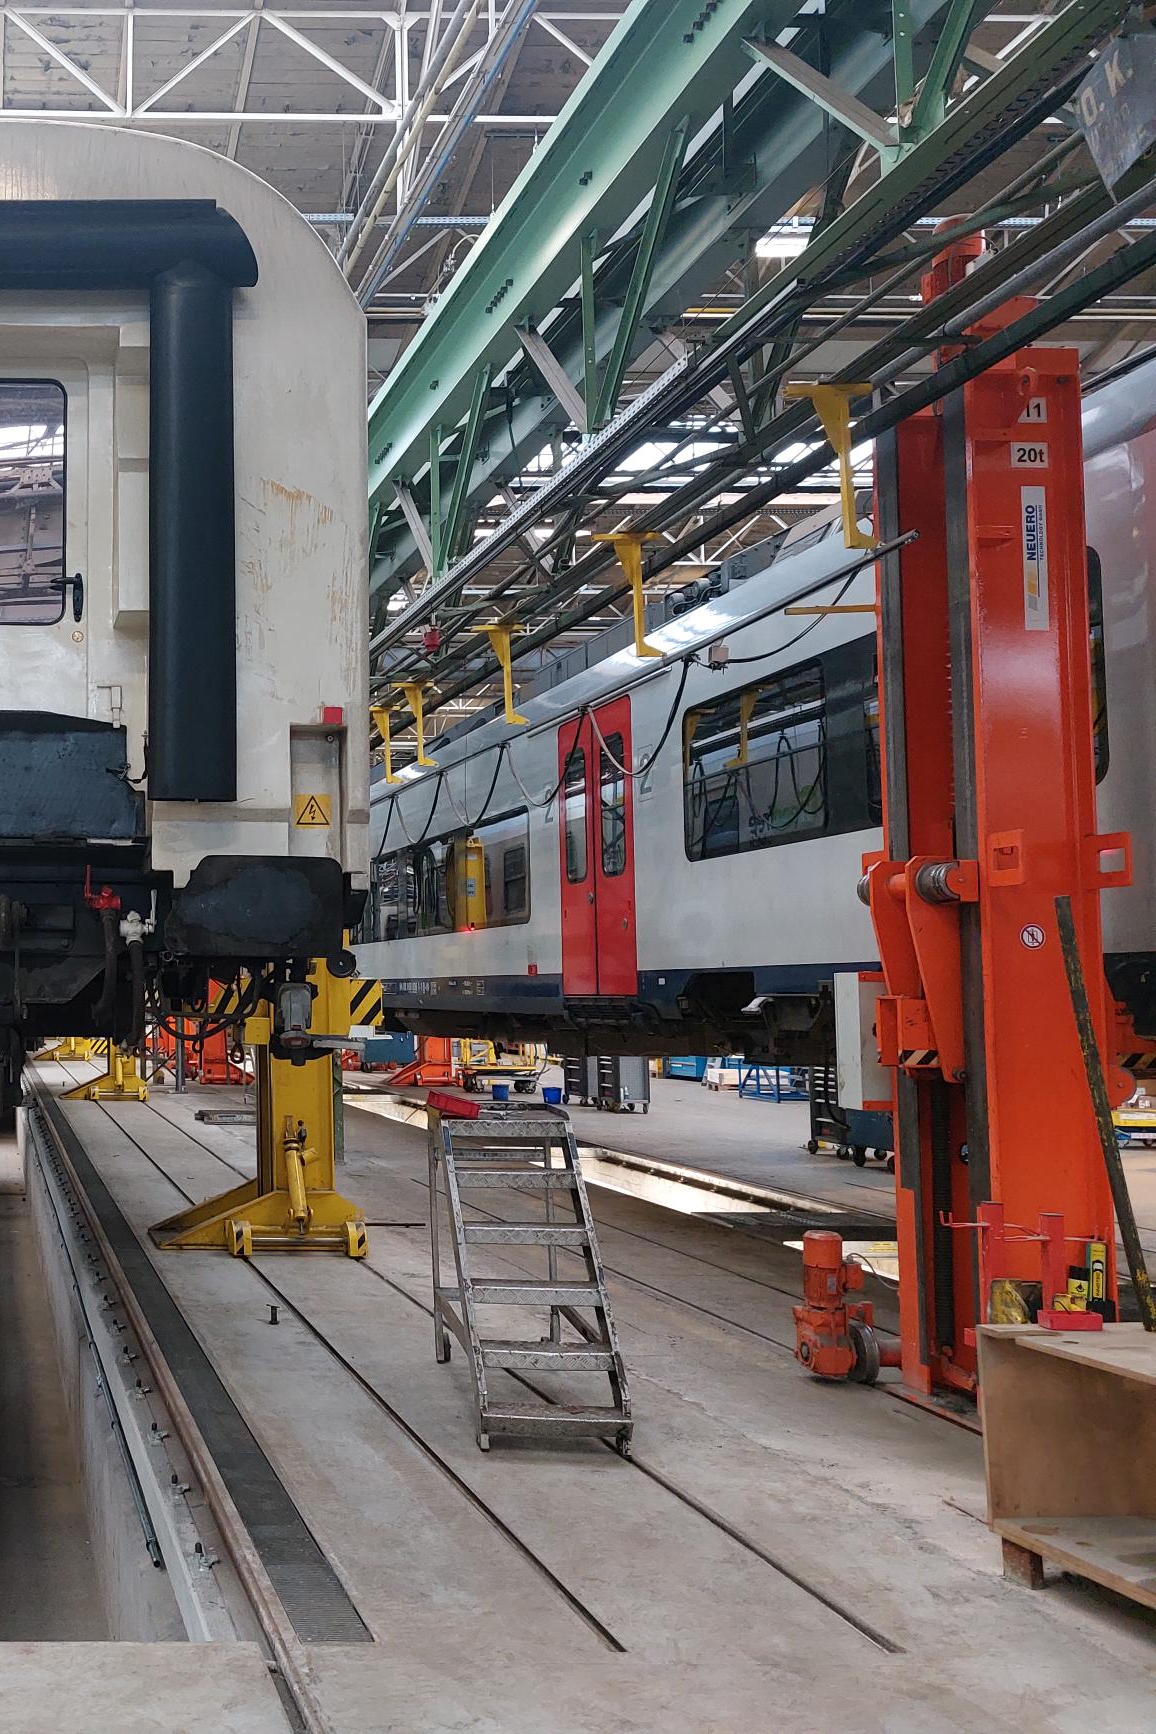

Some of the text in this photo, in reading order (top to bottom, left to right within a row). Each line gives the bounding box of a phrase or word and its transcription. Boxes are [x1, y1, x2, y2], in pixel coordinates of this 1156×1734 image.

[1016, 447, 1045, 463] 20t
[1025, 504, 1037, 561] NEUERO
[640, 752, 653, 795] 2
